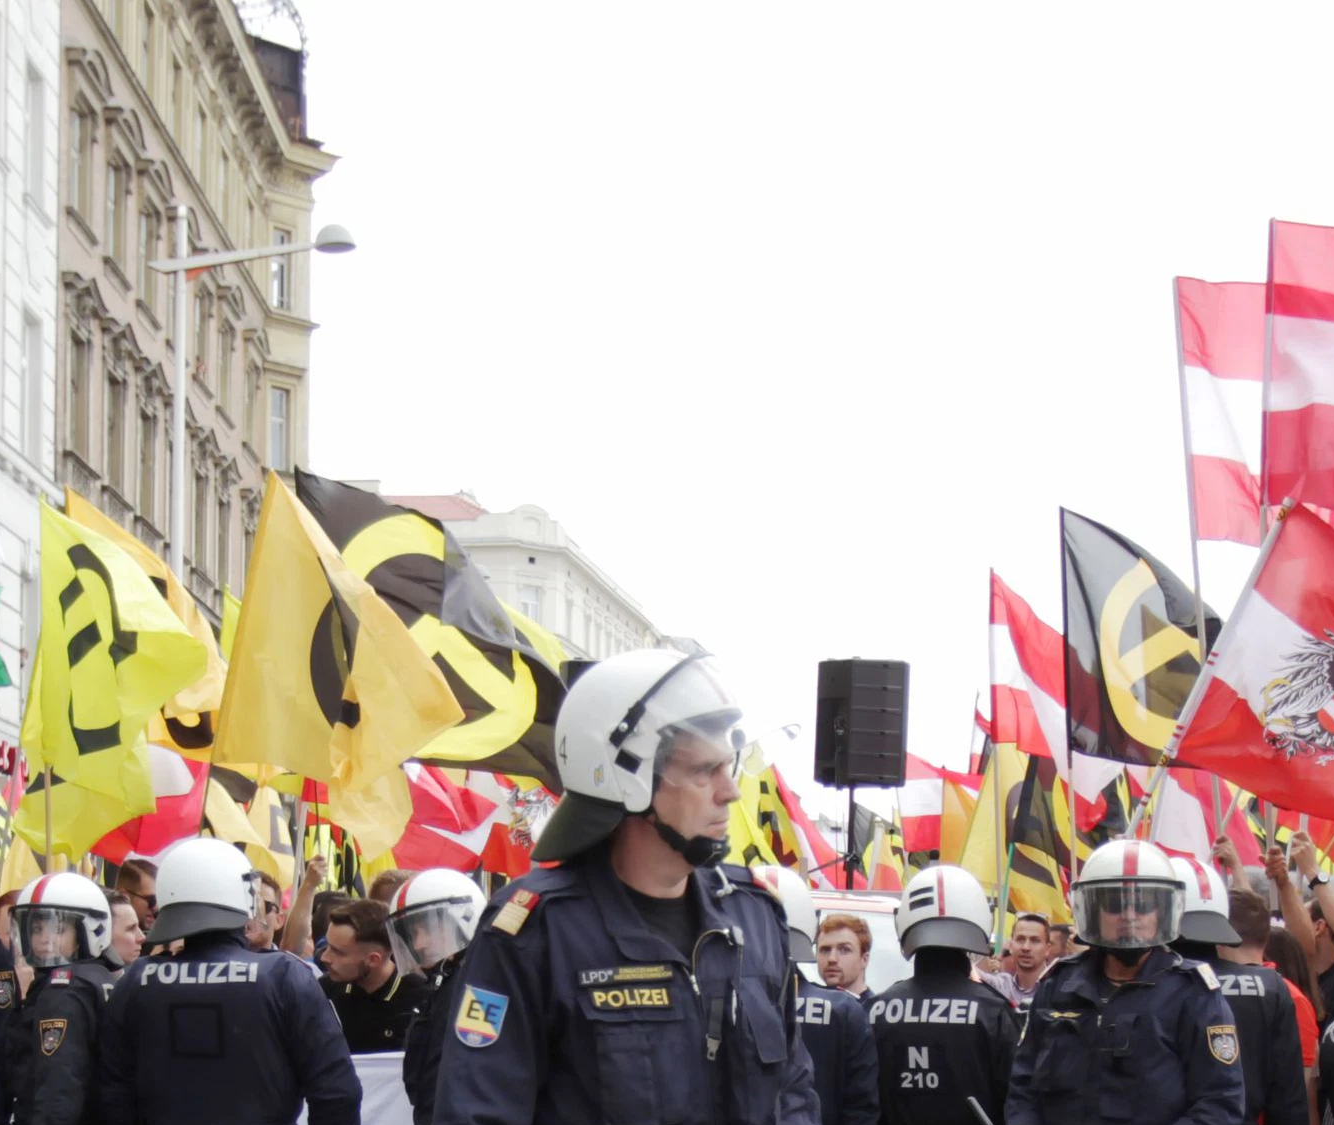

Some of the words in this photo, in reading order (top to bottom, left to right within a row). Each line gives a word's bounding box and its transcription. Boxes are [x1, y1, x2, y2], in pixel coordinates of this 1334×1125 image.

[141, 961, 259, 986] POLIZEI
[593, 987, 670, 1008] POLIZEI
[465, 998, 501, 1026] EE
[869, 999, 979, 1025] POLIZEI
[908, 1046, 929, 1069] N
[900, 1072, 939, 1088] 210
